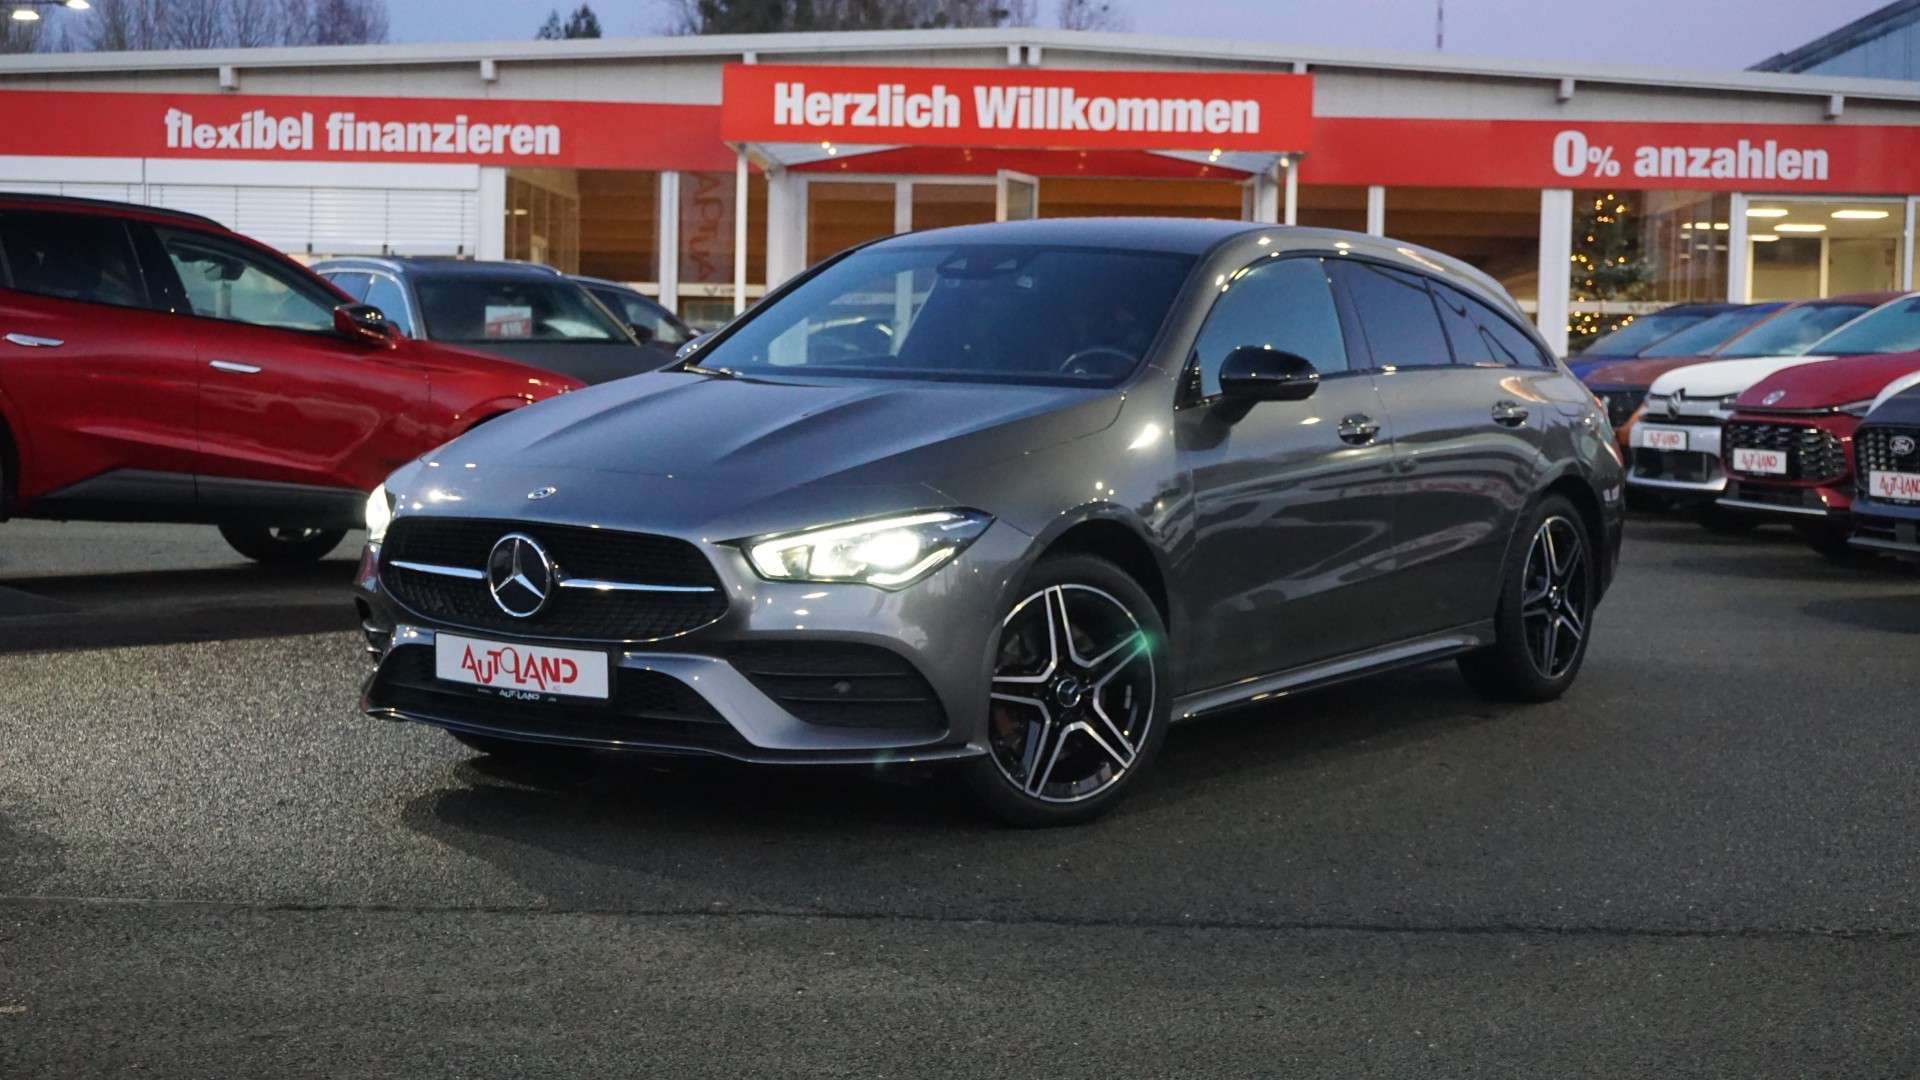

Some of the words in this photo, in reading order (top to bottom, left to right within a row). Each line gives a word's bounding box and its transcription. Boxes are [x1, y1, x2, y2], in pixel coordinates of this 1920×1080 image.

[165, 107, 313, 151] flexibel
[326, 112, 560, 155] finanzieren
[774, 82, 960, 128] Herzlich
[973, 86, 1260, 134] Willkommen
[1553, 130, 1620, 178] 0%
[1634, 139, 1829, 180] anzahlen
[461, 644, 578, 690] AUTOLAND
